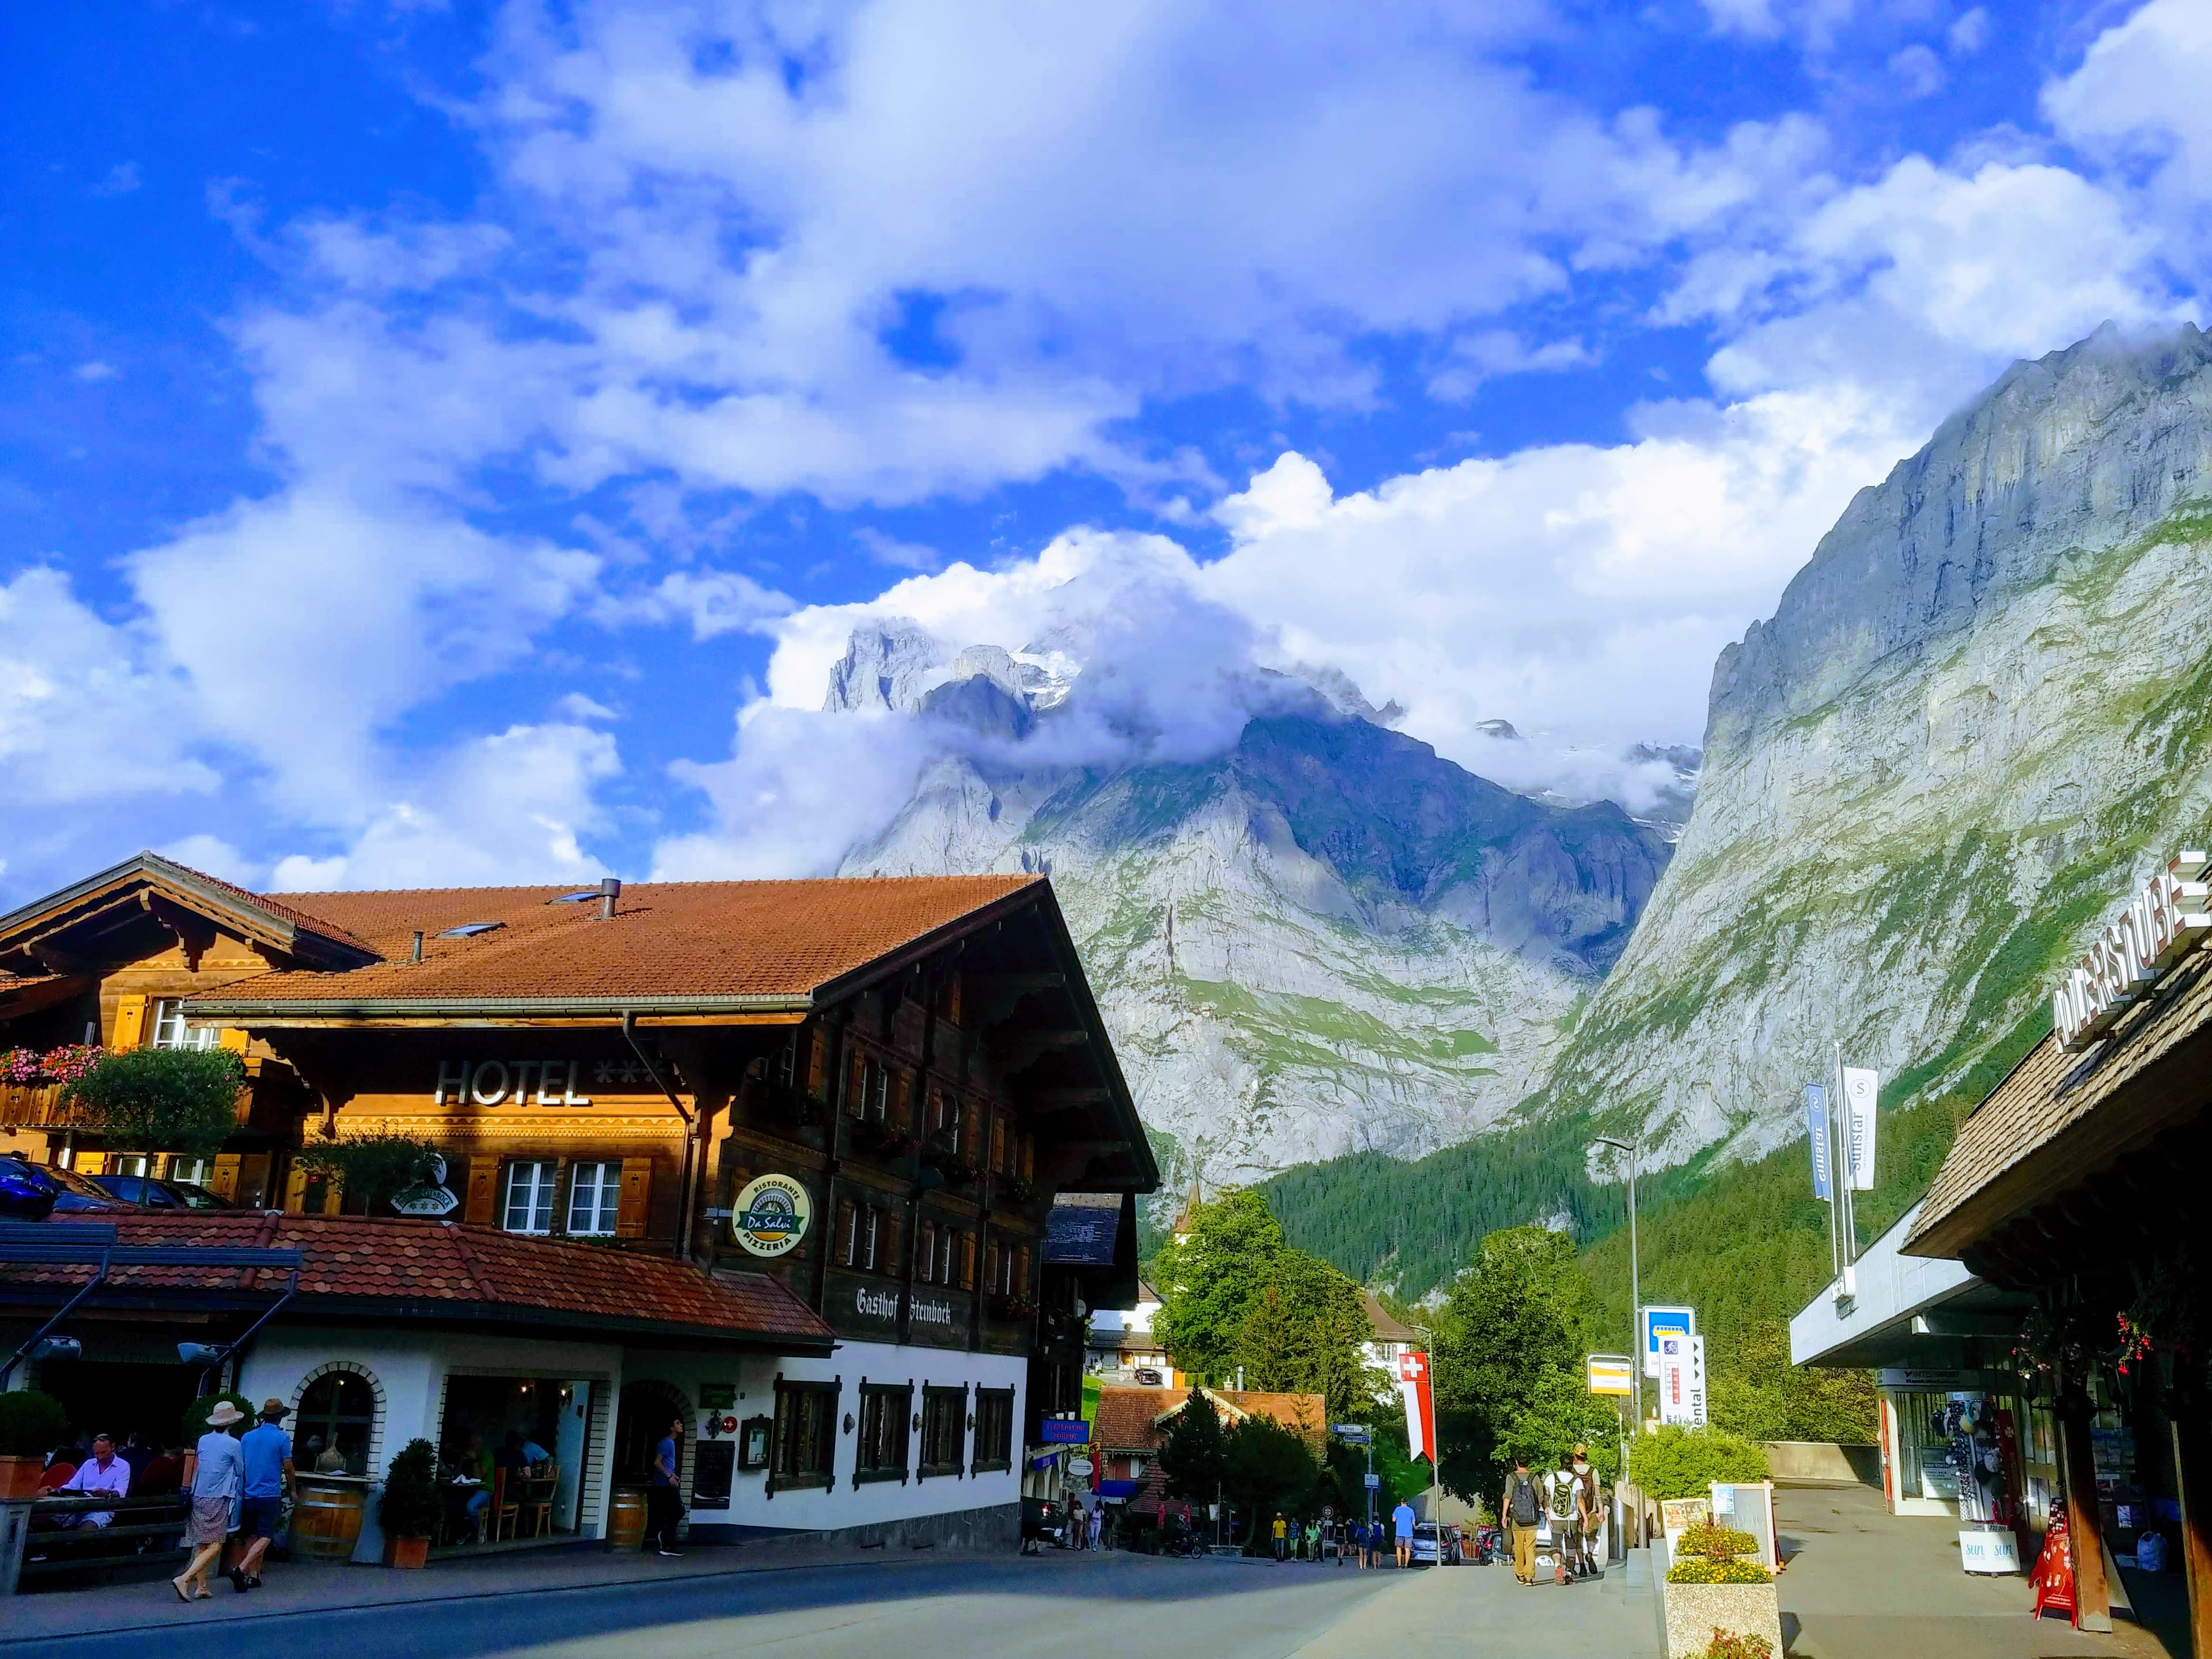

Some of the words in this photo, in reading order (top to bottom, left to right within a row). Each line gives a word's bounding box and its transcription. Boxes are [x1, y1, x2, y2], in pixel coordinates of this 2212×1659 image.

[2053, 851, 2211, 1054] ADLERSTUBE
[435, 1060, 592, 1105] HOTEL
[753, 1181, 800, 1200] RISTORANTE
[747, 1216, 762, 1229] Da
[764, 1216, 791, 1229] Salvi
[743, 1232, 791, 1250] PIZZERIA
[857, 1287, 899, 1323] Gasthof
[909, 1295, 950, 1325] Steinbock
